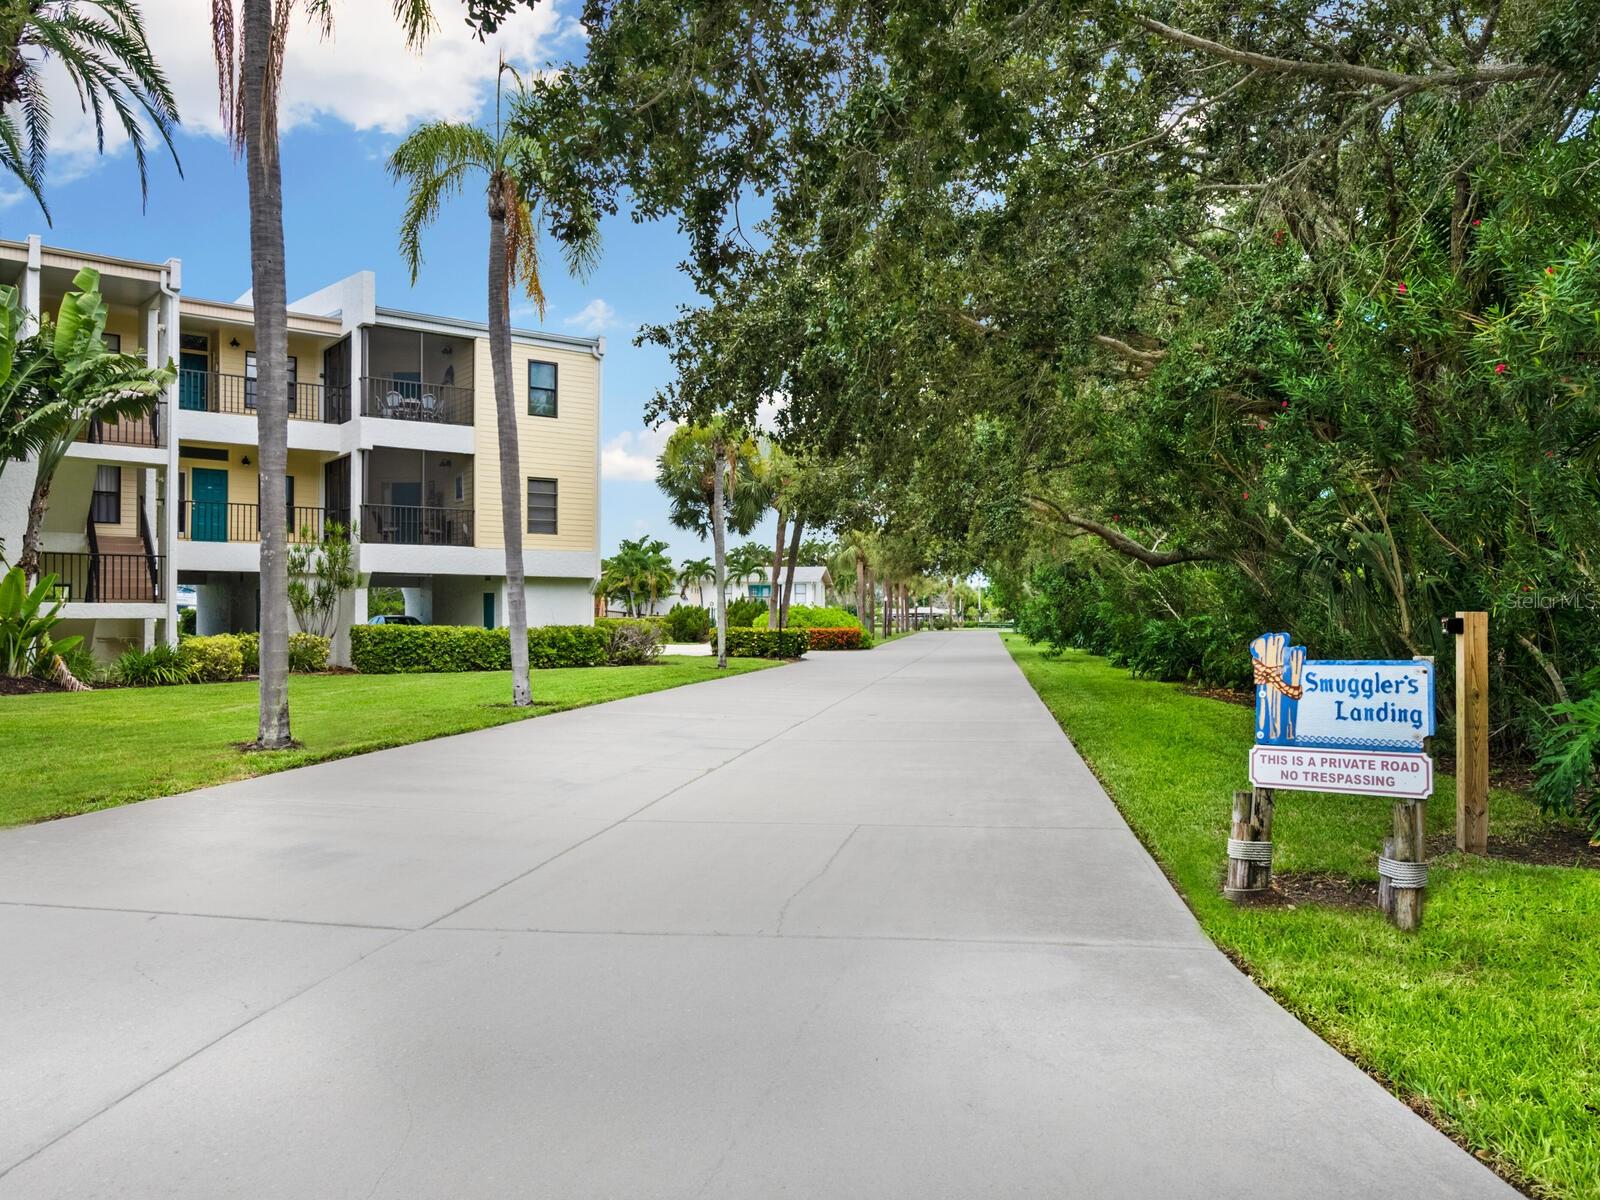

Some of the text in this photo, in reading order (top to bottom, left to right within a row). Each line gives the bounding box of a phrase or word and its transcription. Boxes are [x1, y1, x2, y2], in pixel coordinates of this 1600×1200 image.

[1305, 672, 1419, 699] Smuggler's
[1334, 700, 1423, 729] Landing
[1260, 754, 1420, 773] THIS IS A PRIVATE ROAD
[1280, 770, 1395, 787] NO TRESPASSING
